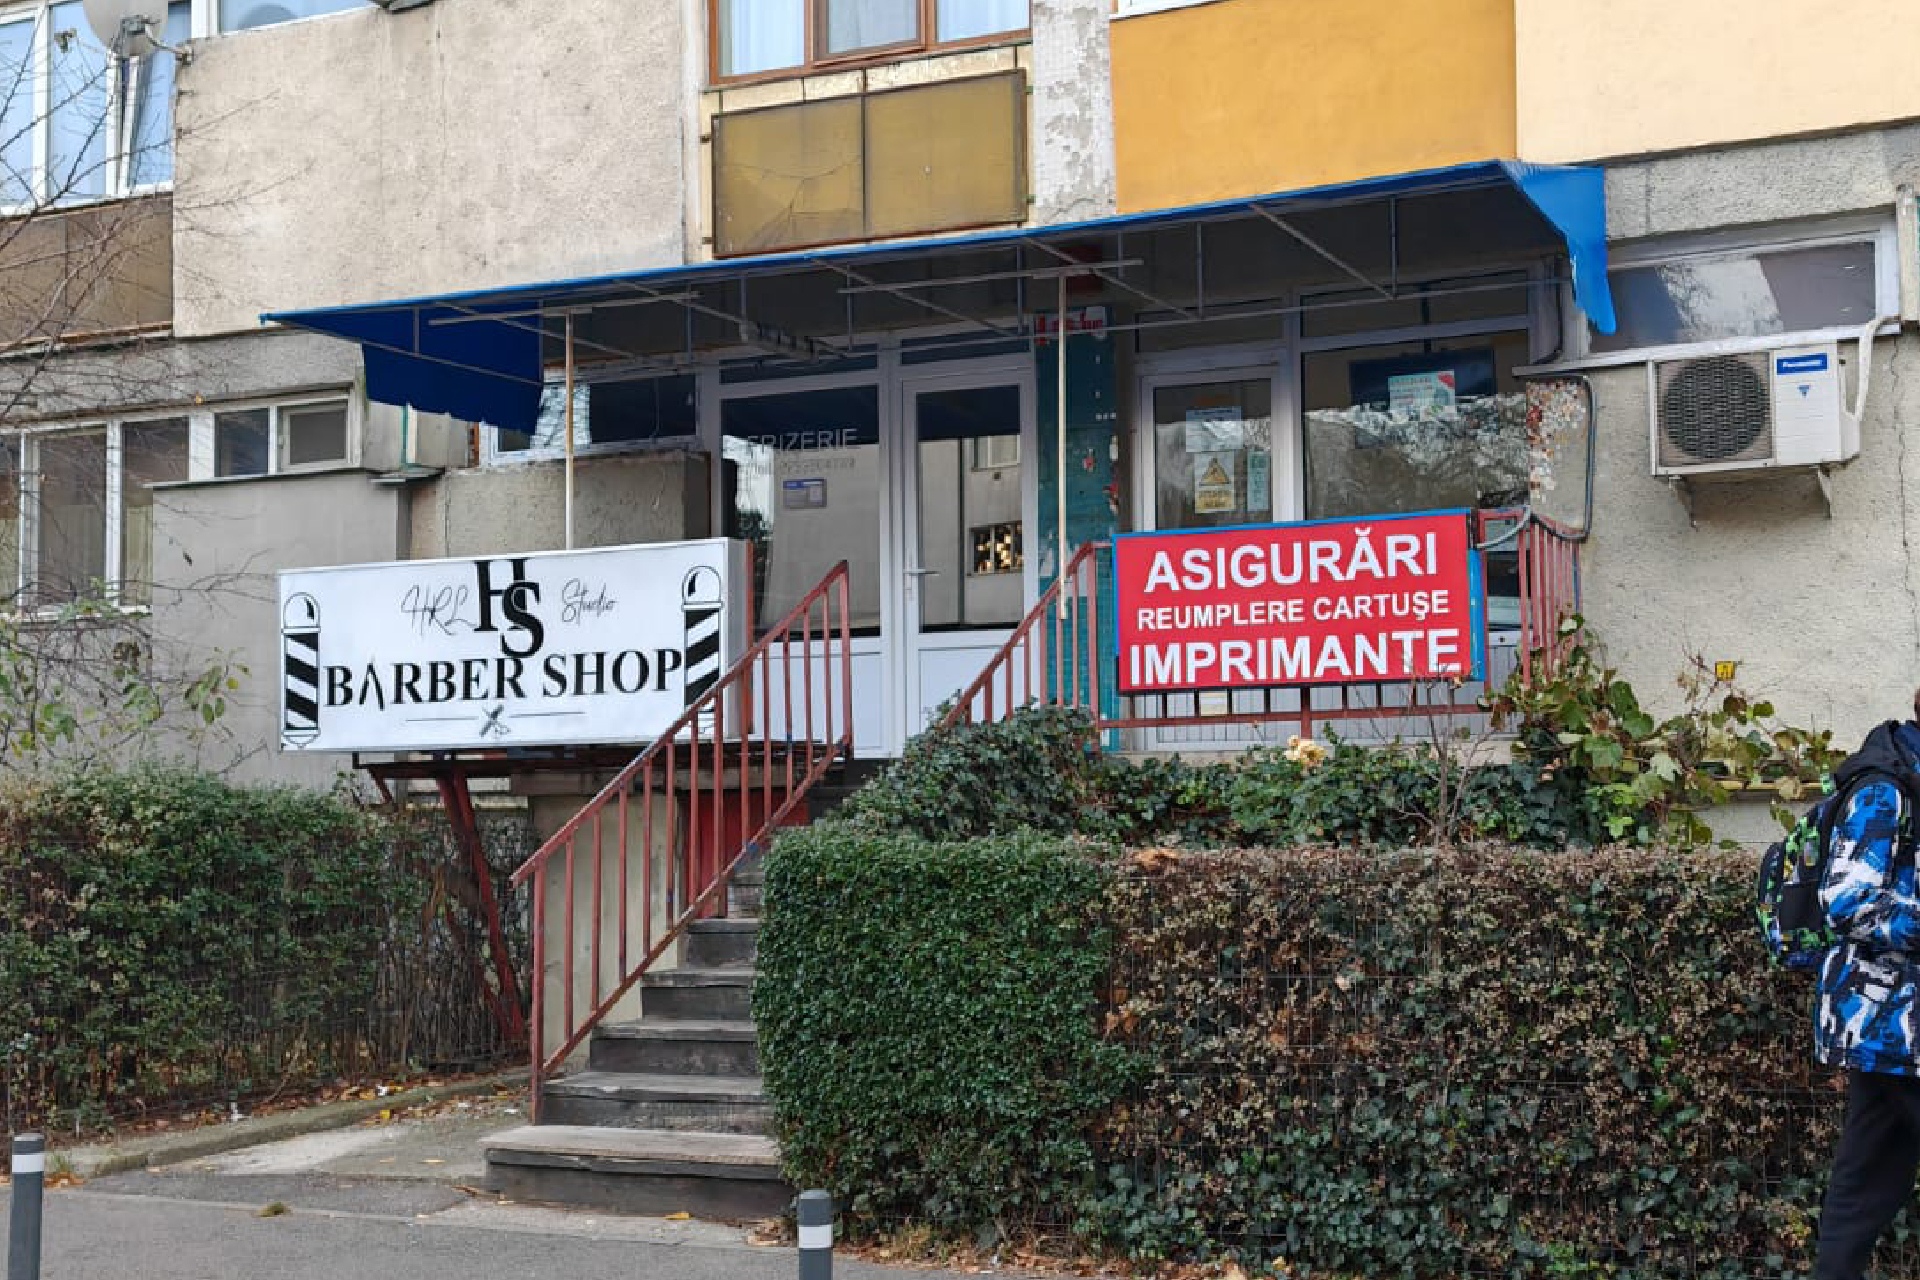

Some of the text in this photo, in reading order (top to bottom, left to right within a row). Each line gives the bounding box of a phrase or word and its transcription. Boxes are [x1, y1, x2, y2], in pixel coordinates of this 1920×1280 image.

[1144, 527, 1438, 593] ASIGURĂRI
[1137, 599, 1305, 631] REUMPLERE
[324, 648, 683, 711] BARBER SHOP
[1130, 628, 1462, 686] IMPRIMANTE
